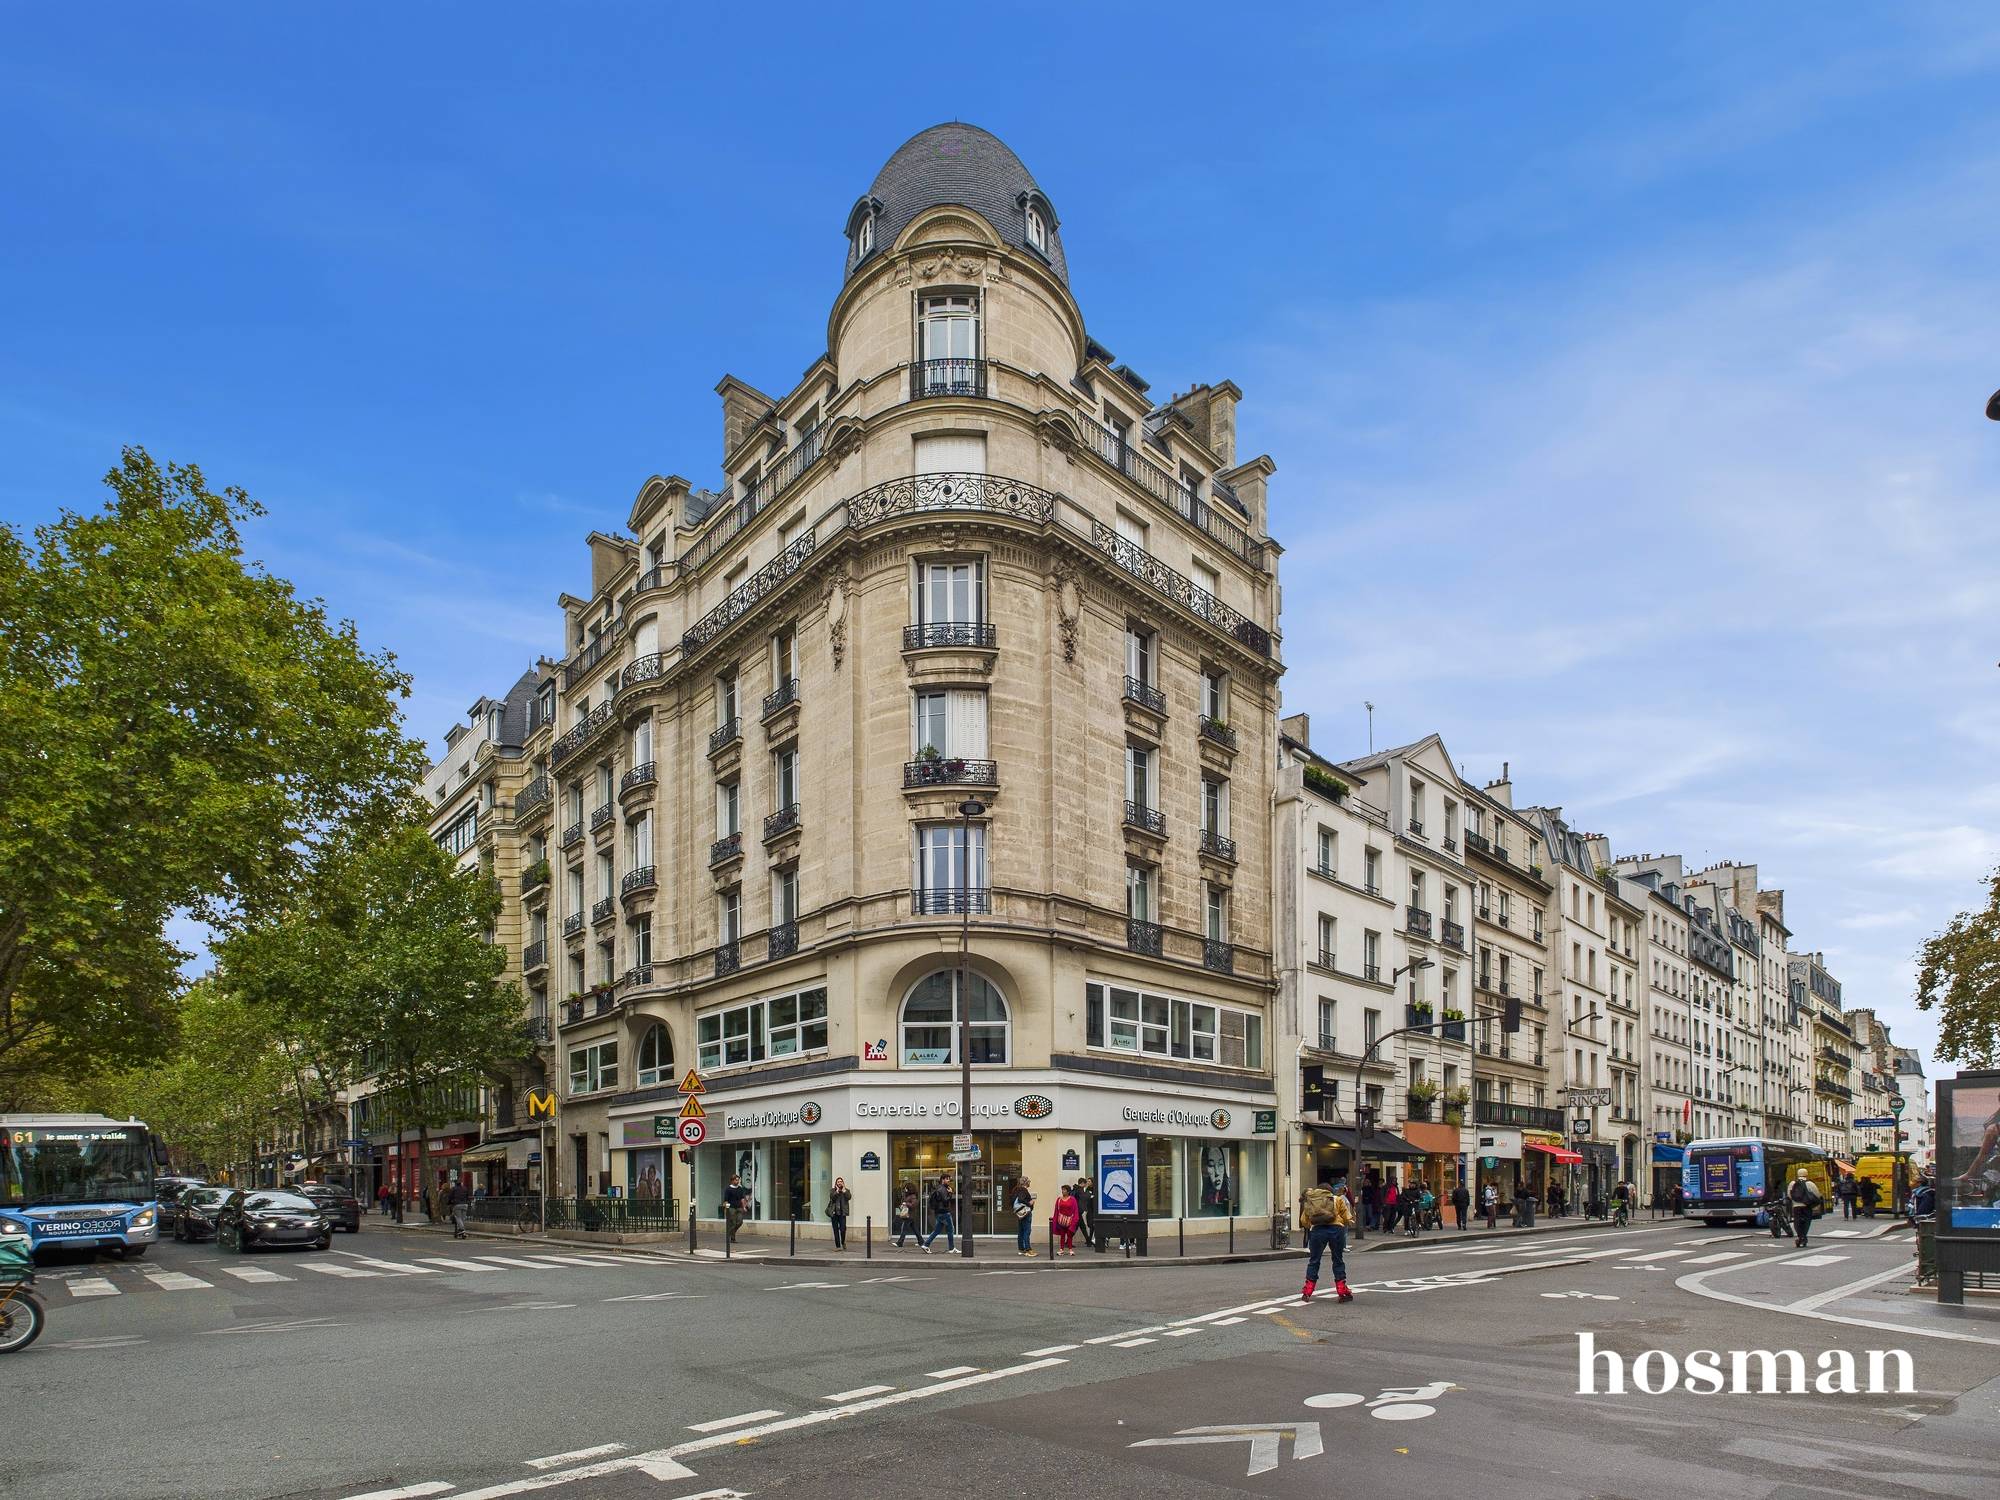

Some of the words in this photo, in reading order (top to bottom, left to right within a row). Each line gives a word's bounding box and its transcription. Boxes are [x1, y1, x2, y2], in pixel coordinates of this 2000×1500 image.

[529, 1092, 556, 1117] M
[1569, 1095, 1608, 1106] RINCK
[856, 1101, 927, 1117] Generale
[1123, 1105, 1166, 1123] Generale
[14, 1131, 33, 1143] 61
[686, 1127, 700, 1137] 30
[38, 1222, 81, 1232] VERINO
